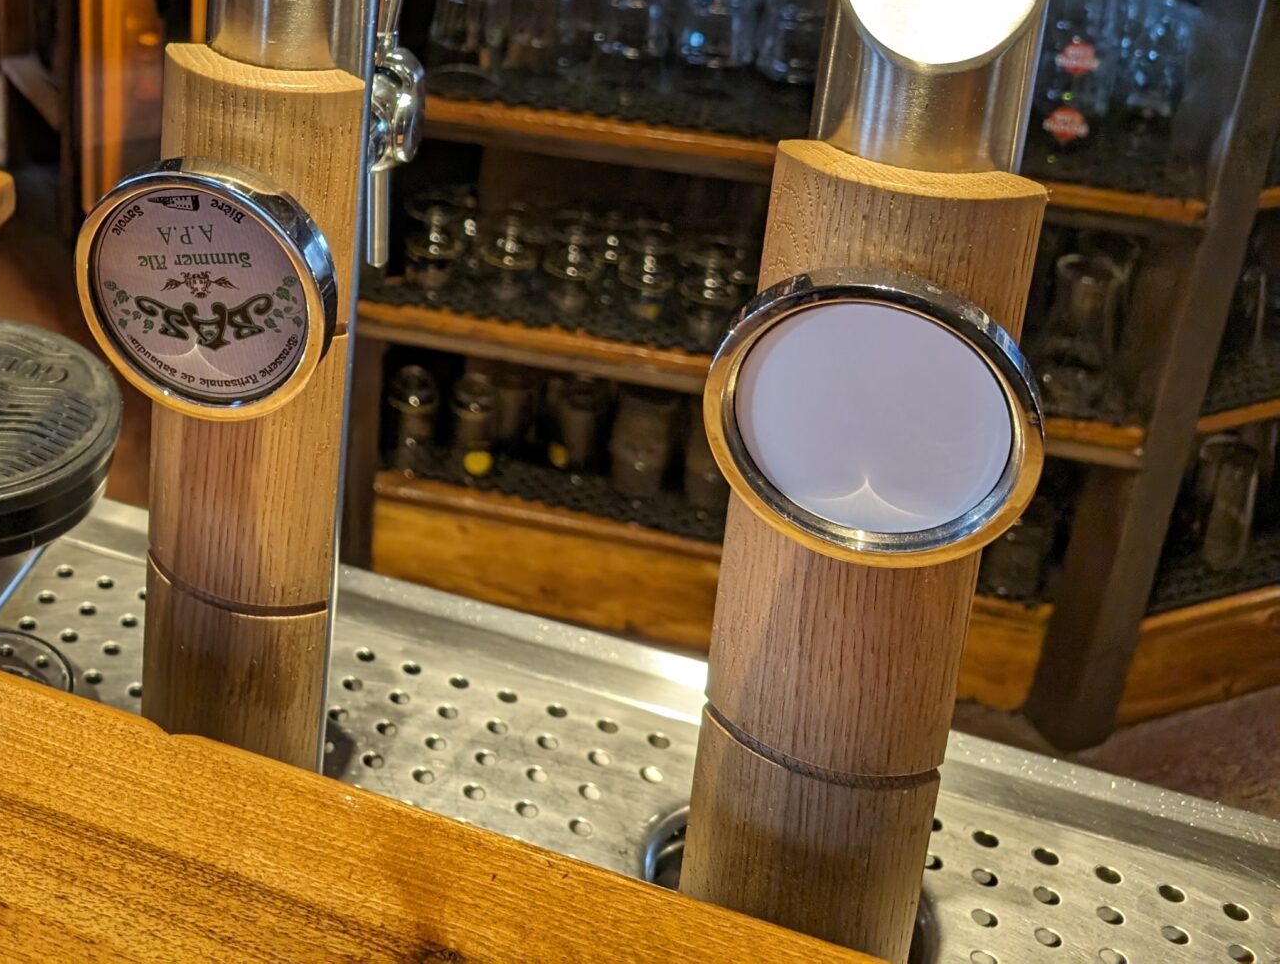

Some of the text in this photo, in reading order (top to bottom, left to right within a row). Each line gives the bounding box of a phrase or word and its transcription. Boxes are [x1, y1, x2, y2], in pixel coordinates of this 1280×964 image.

[111, 204, 144, 236] Savoie
[210, 198, 246, 224] Bière
[156, 224, 213, 246] A.P.A
[137, 251, 252, 271] Summer Ale
[258, 337, 297, 379] Brasserie
[179, 371, 196, 383] de
[200, 370, 260, 390] Artisanale
